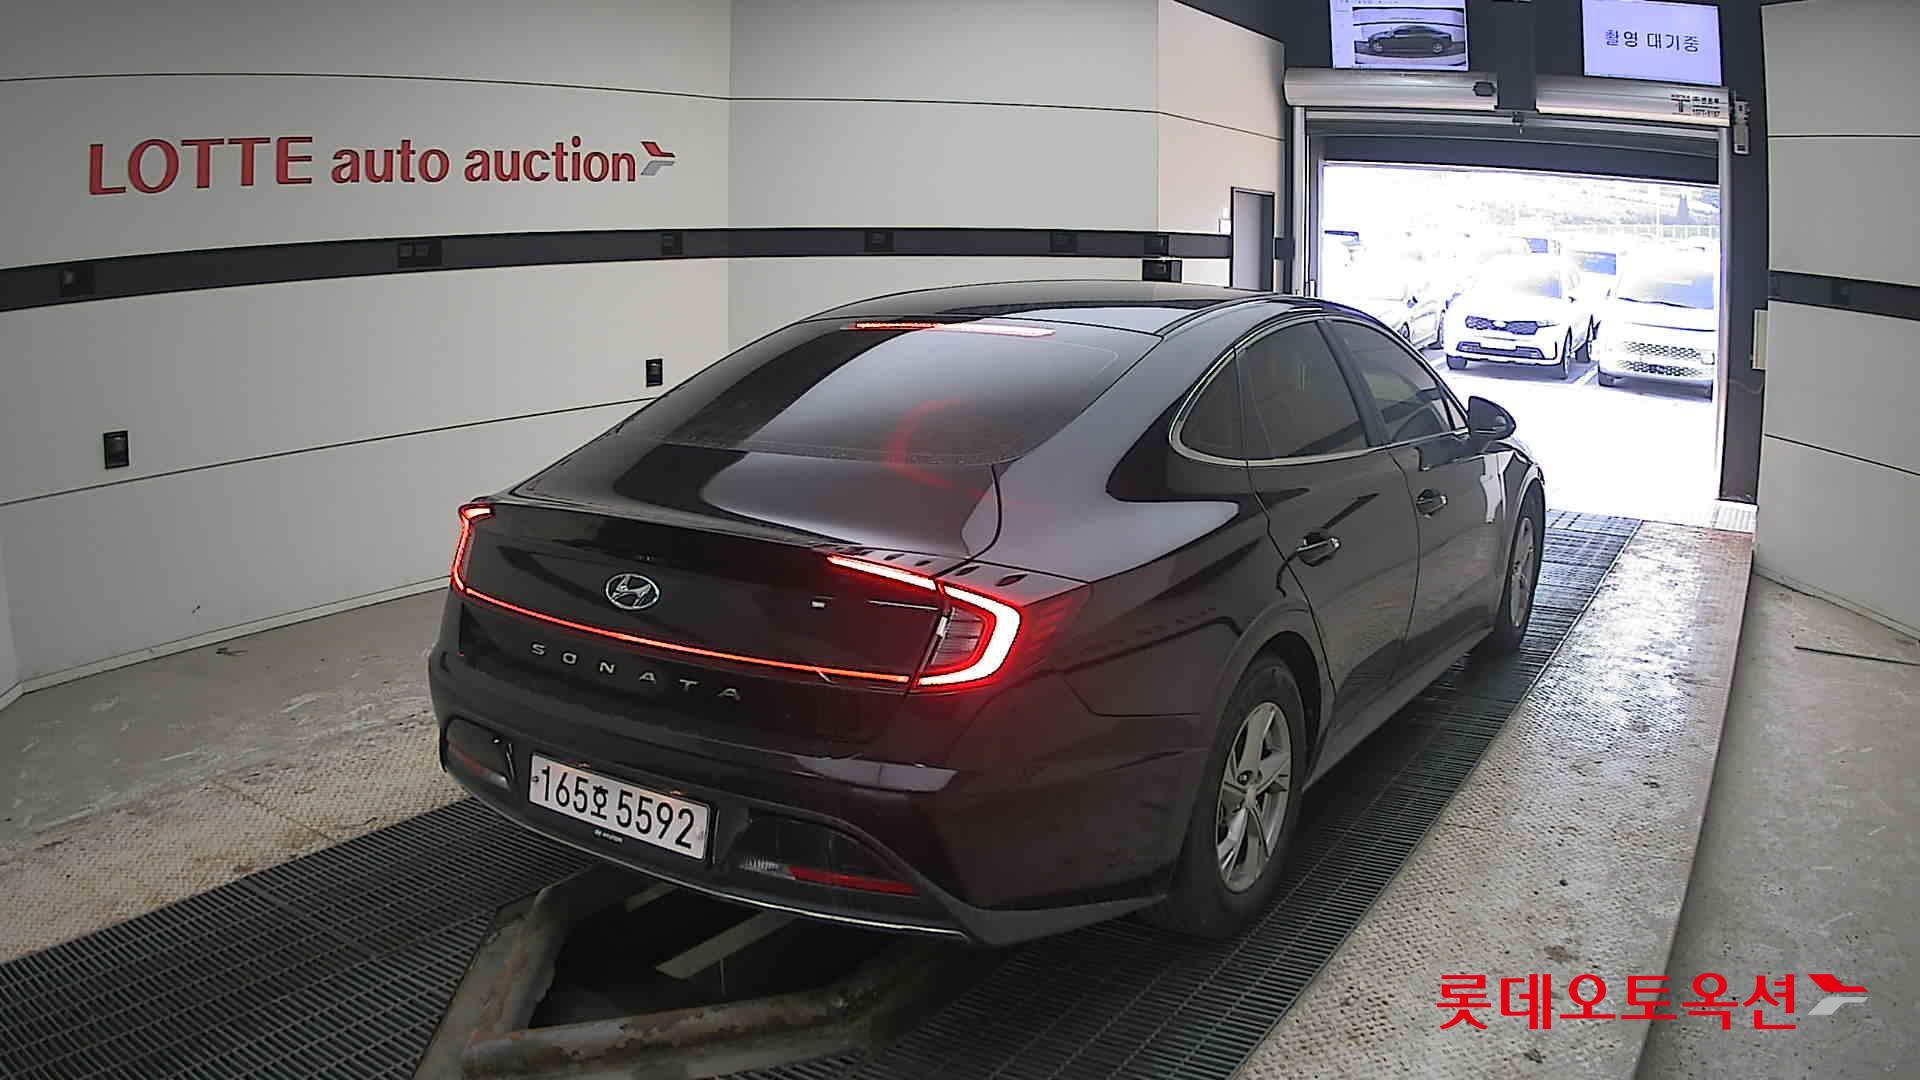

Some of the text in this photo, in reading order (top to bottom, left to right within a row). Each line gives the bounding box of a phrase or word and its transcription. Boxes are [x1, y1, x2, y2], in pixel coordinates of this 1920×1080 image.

[1606, 29, 1700, 52] 촬영 대기중
[89, 136, 637, 196] LOTTE auto auction
[531, 643, 740, 700] SONATA
